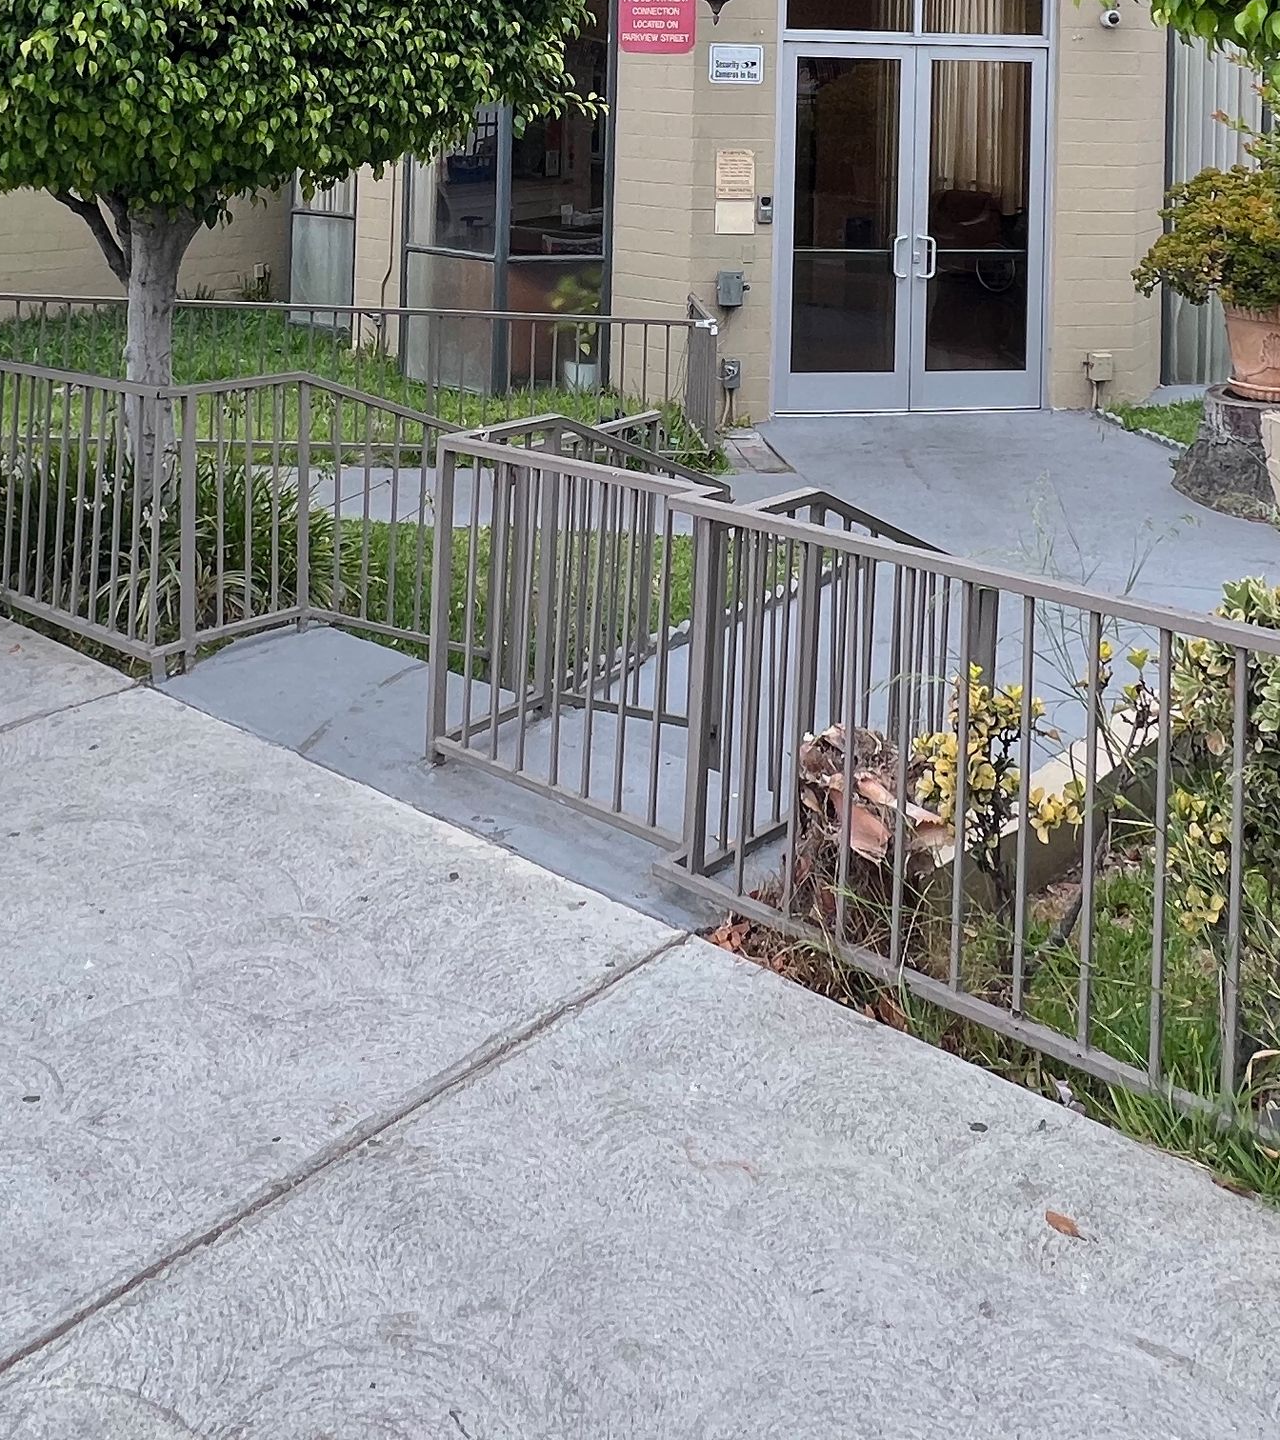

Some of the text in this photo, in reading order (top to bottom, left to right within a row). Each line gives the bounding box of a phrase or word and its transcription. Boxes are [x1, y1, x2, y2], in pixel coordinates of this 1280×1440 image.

[632, 7, 680, 15] CONNECTION
[633, 20, 678, 28] LOCATED ON
[622, 33, 689, 42] PARKVIEW STREET
[715, 60, 739, 70] Security
[715, 70, 738, 79] Cameras
